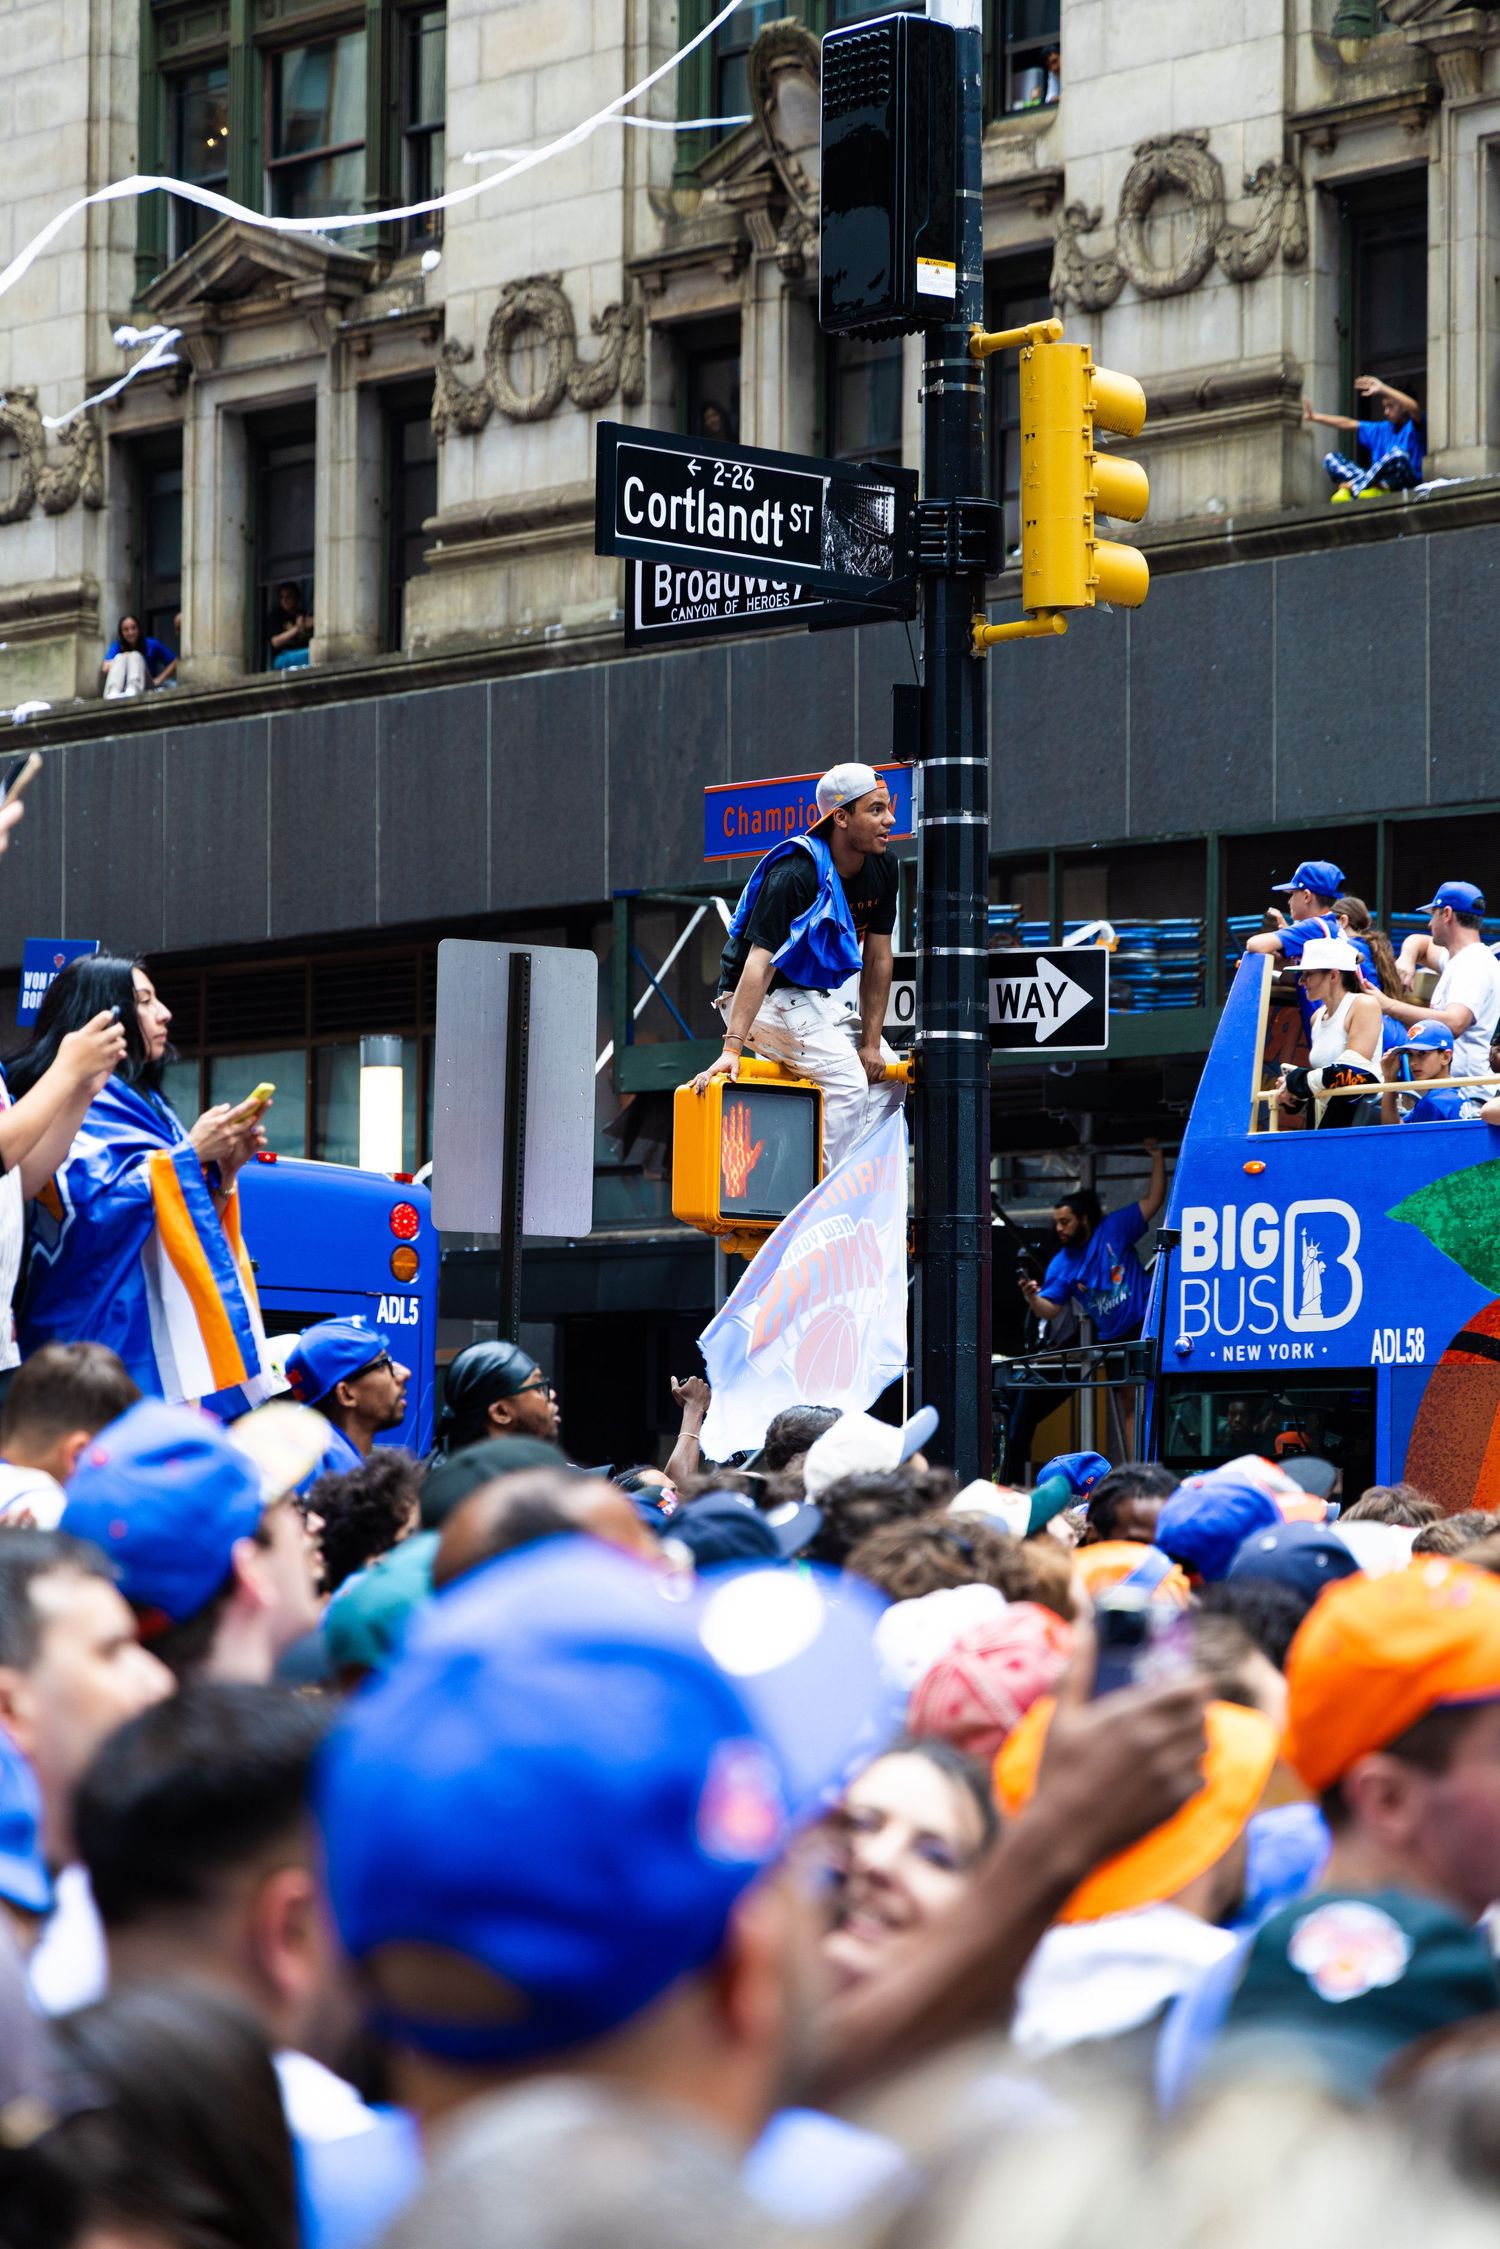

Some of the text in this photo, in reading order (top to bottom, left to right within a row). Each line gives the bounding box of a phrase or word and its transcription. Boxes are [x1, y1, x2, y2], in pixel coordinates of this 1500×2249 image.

[713, 461, 754, 491] 2-26
[623, 476, 814, 547] Cortlandt ST
[671, 592, 790, 622] CANYON OF HEROES
[723, 796, 818, 838] Champio
[996, 981, 1068, 1019] WAY
[1180, 1202, 1280, 1273] BIG
[376, 1295, 419, 1326] ADL5
[1179, 1274, 1279, 1338] BUS
[1222, 1342, 1316, 1362] NEW YORK
[1370, 1327, 1426, 1365] ADL58
